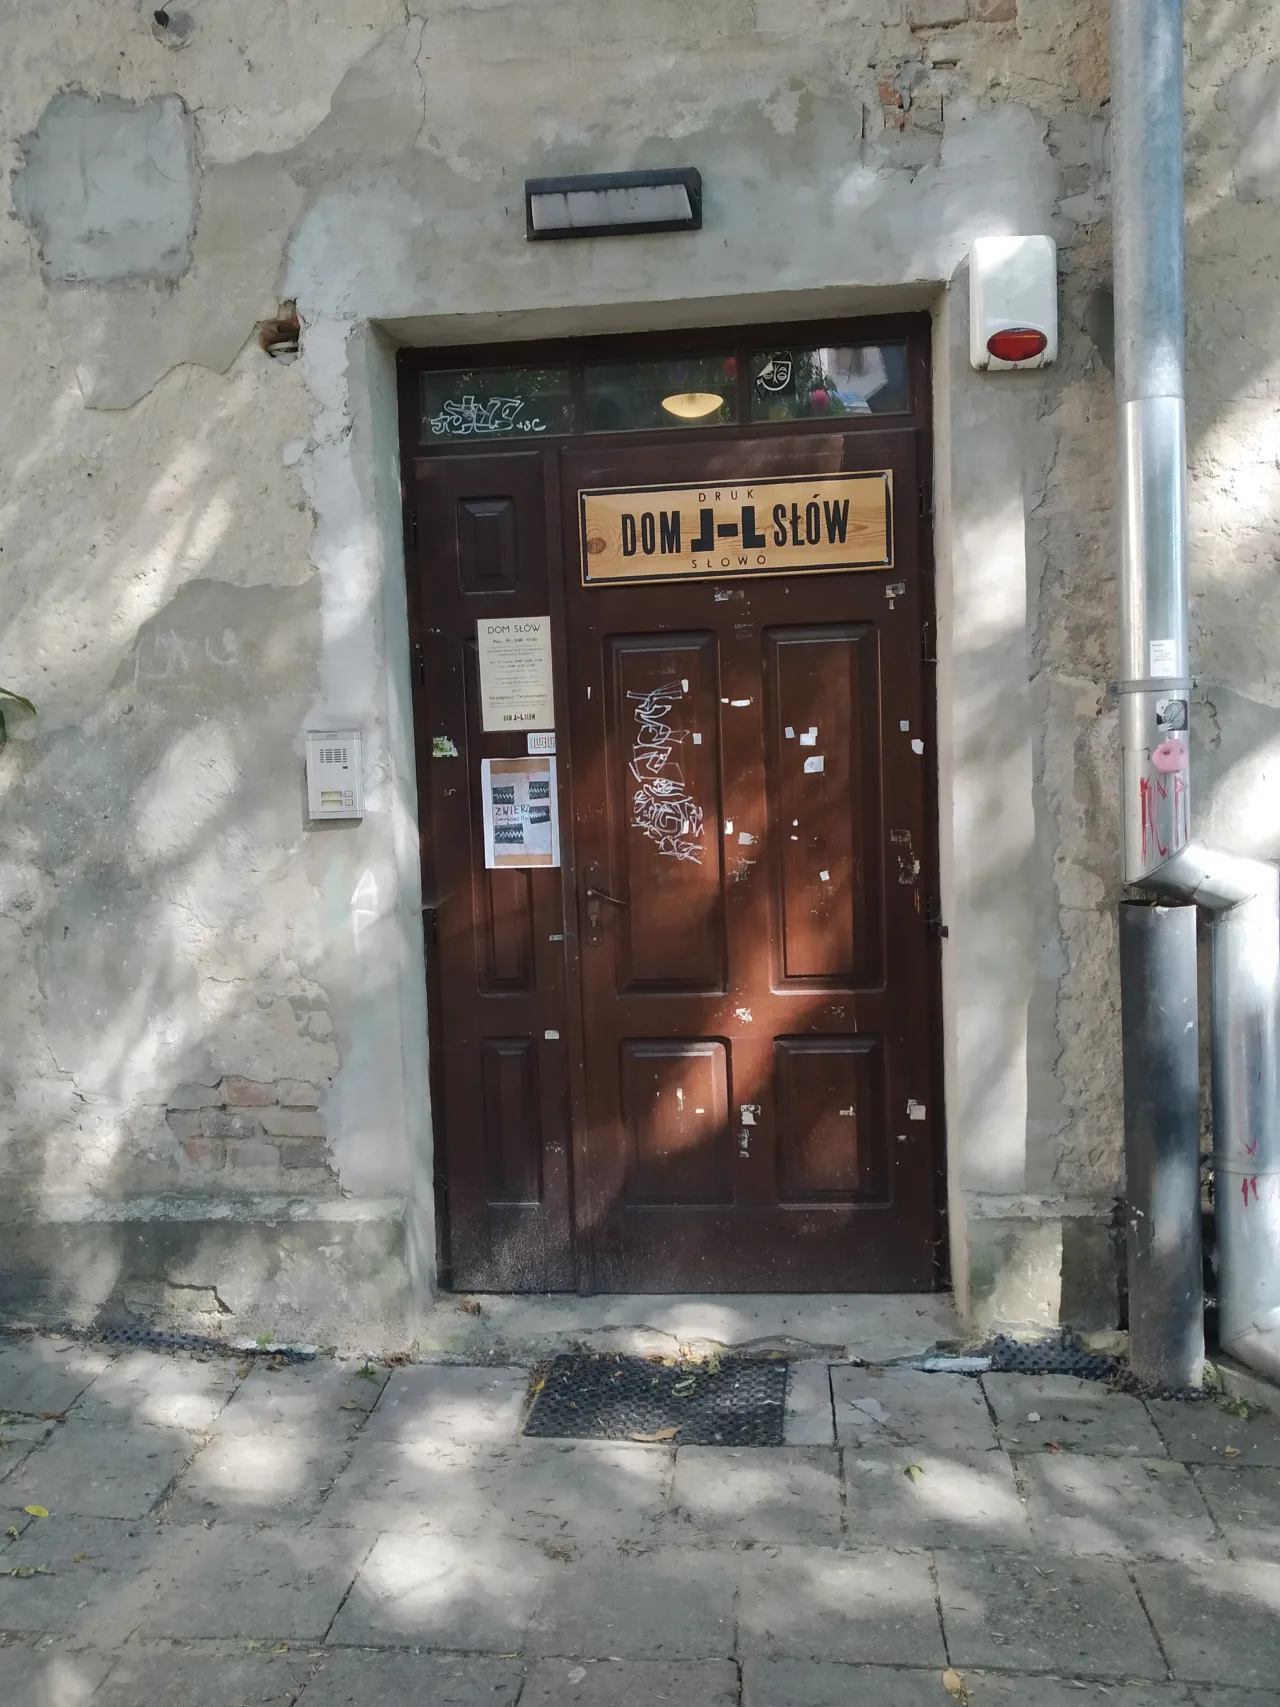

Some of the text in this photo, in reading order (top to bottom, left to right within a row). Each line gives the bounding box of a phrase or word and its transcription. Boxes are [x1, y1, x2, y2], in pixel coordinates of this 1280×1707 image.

[698, 488, 754, 503] DRUK
[621, 510, 681, 557] DOM
[772, 493, 850, 547] SŁÓW
[691, 554, 766, 569] SŁOWO
[487, 623, 541, 635] DOM SŁÓW
